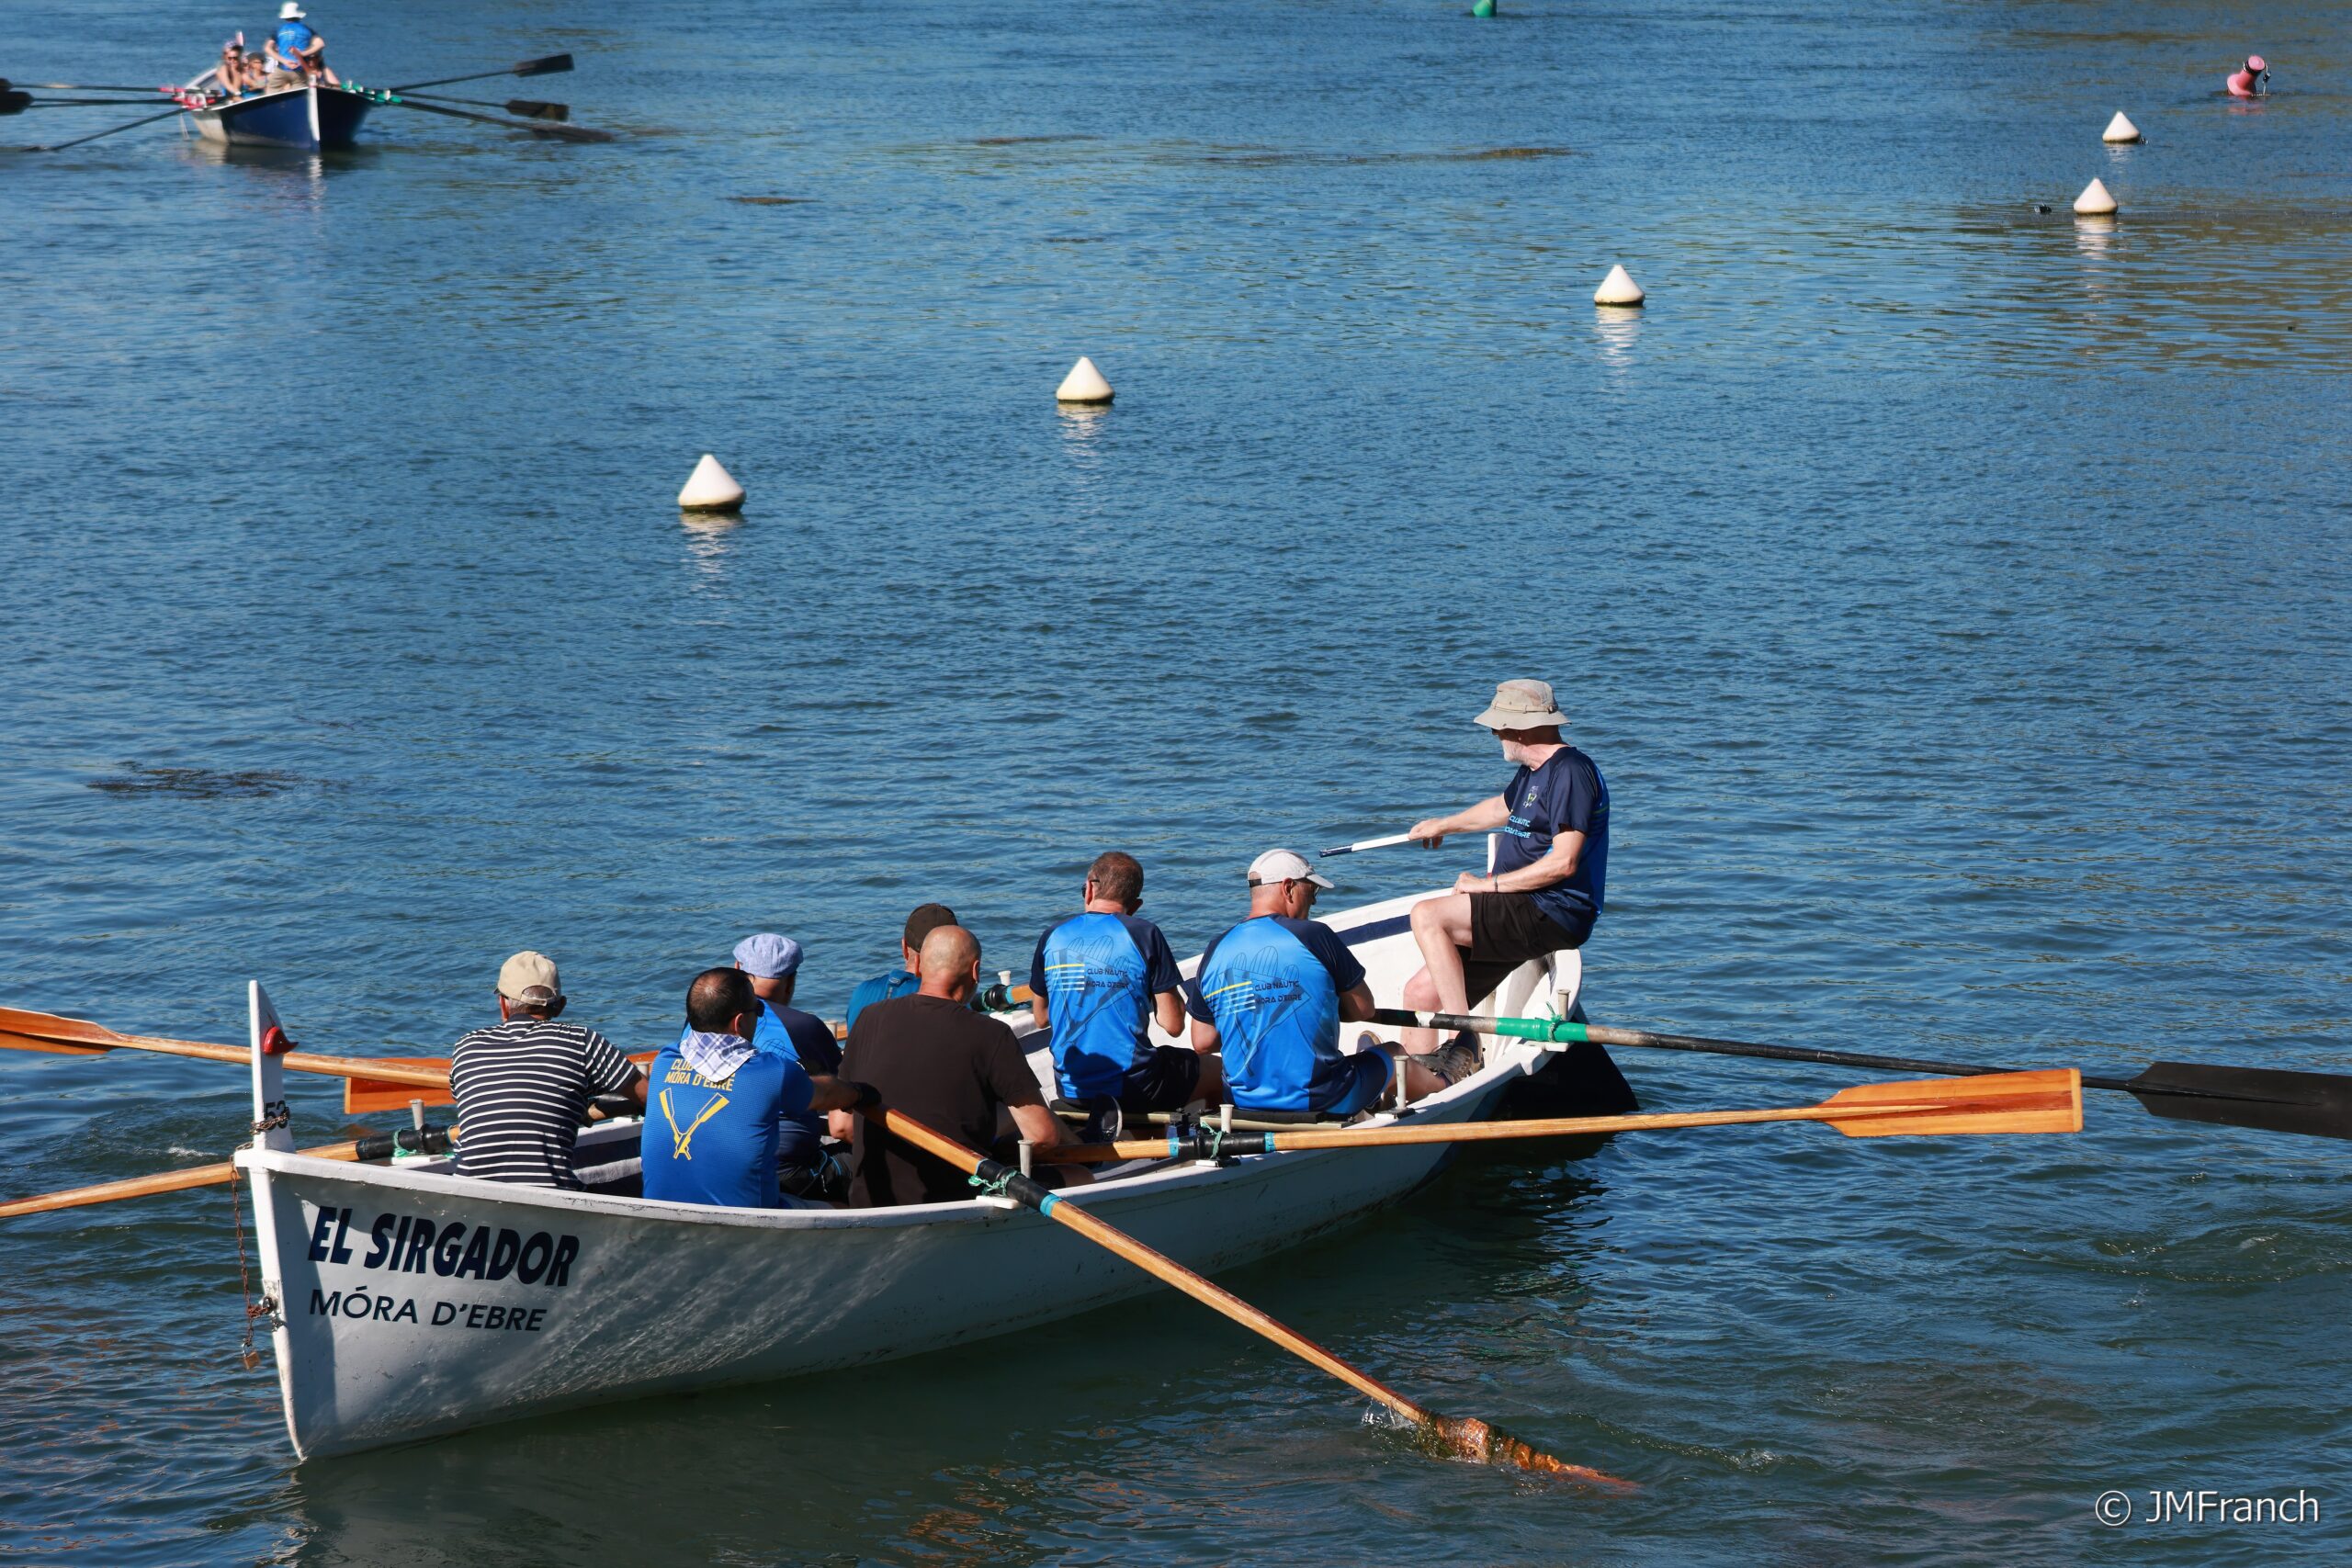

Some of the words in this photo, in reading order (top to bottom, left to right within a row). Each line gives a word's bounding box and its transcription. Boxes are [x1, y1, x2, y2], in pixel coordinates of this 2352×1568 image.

[1255, 983, 1272, 991] CLUB
[308, 1205, 354, 1265] EL
[363, 1213, 581, 1287] SIRGADOR
[310, 1285, 419, 1325] MÓRA
[431, 1301, 548, 1332] D'EBRE
